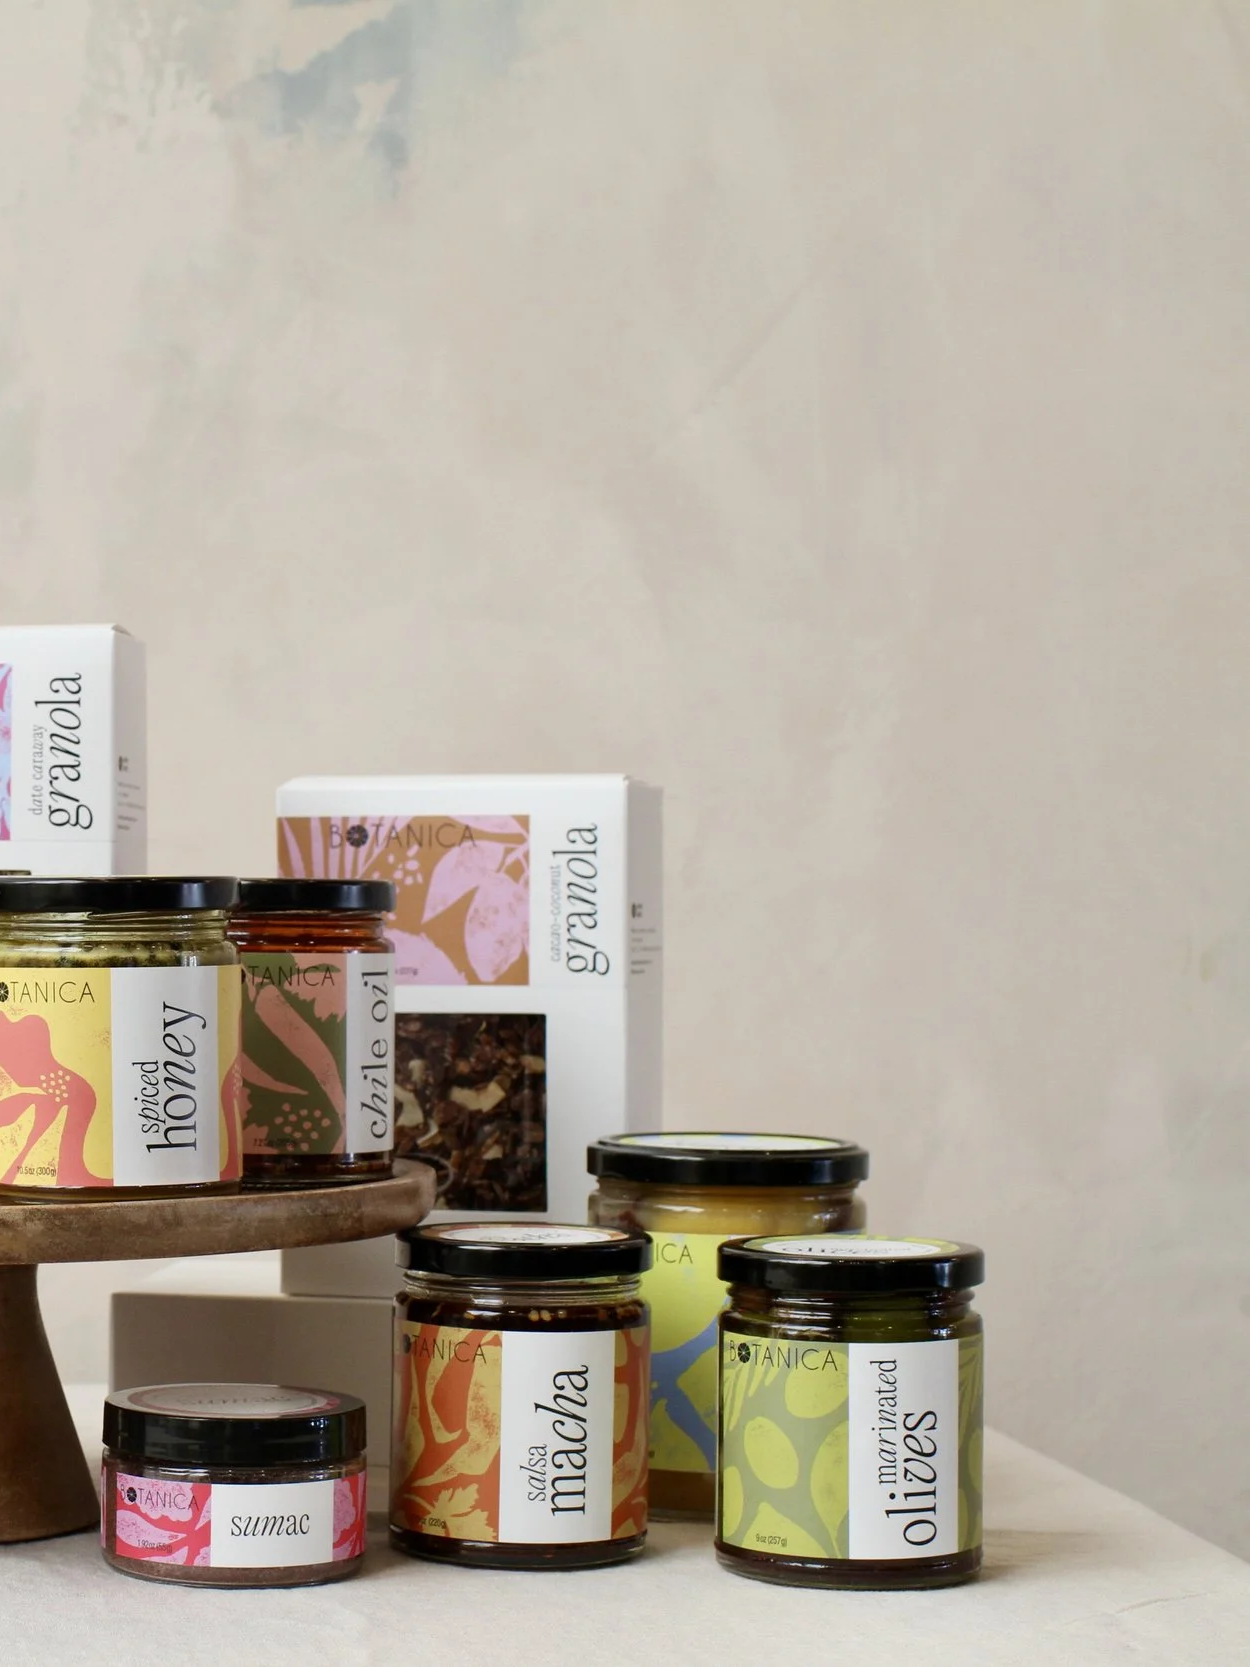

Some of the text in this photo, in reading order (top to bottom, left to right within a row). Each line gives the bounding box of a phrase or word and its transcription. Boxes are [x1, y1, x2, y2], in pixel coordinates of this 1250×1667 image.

[28, 724, 48, 816] date caraway
[34, 672, 93, 830] granola
[329, 822, 478, 849] BOTANICA
[552, 822, 610, 976] granola
[241, 965, 335, 987] TANICA
[132, 1059, 160, 1134] spiced
[145, 1001, 207, 1153] honey
[360, 969, 390, 1140] chile oil
[729, 1339, 838, 1373] BOTANICA
[534, 1364, 590, 1517] macha
[869, 1358, 899, 1485] marinated
[120, 1483, 200, 1511] BOTANICA
[518, 1443, 548, 1502] salsa
[884, 1409, 938, 1546] olives
[230, 1513, 310, 1537] sumac
